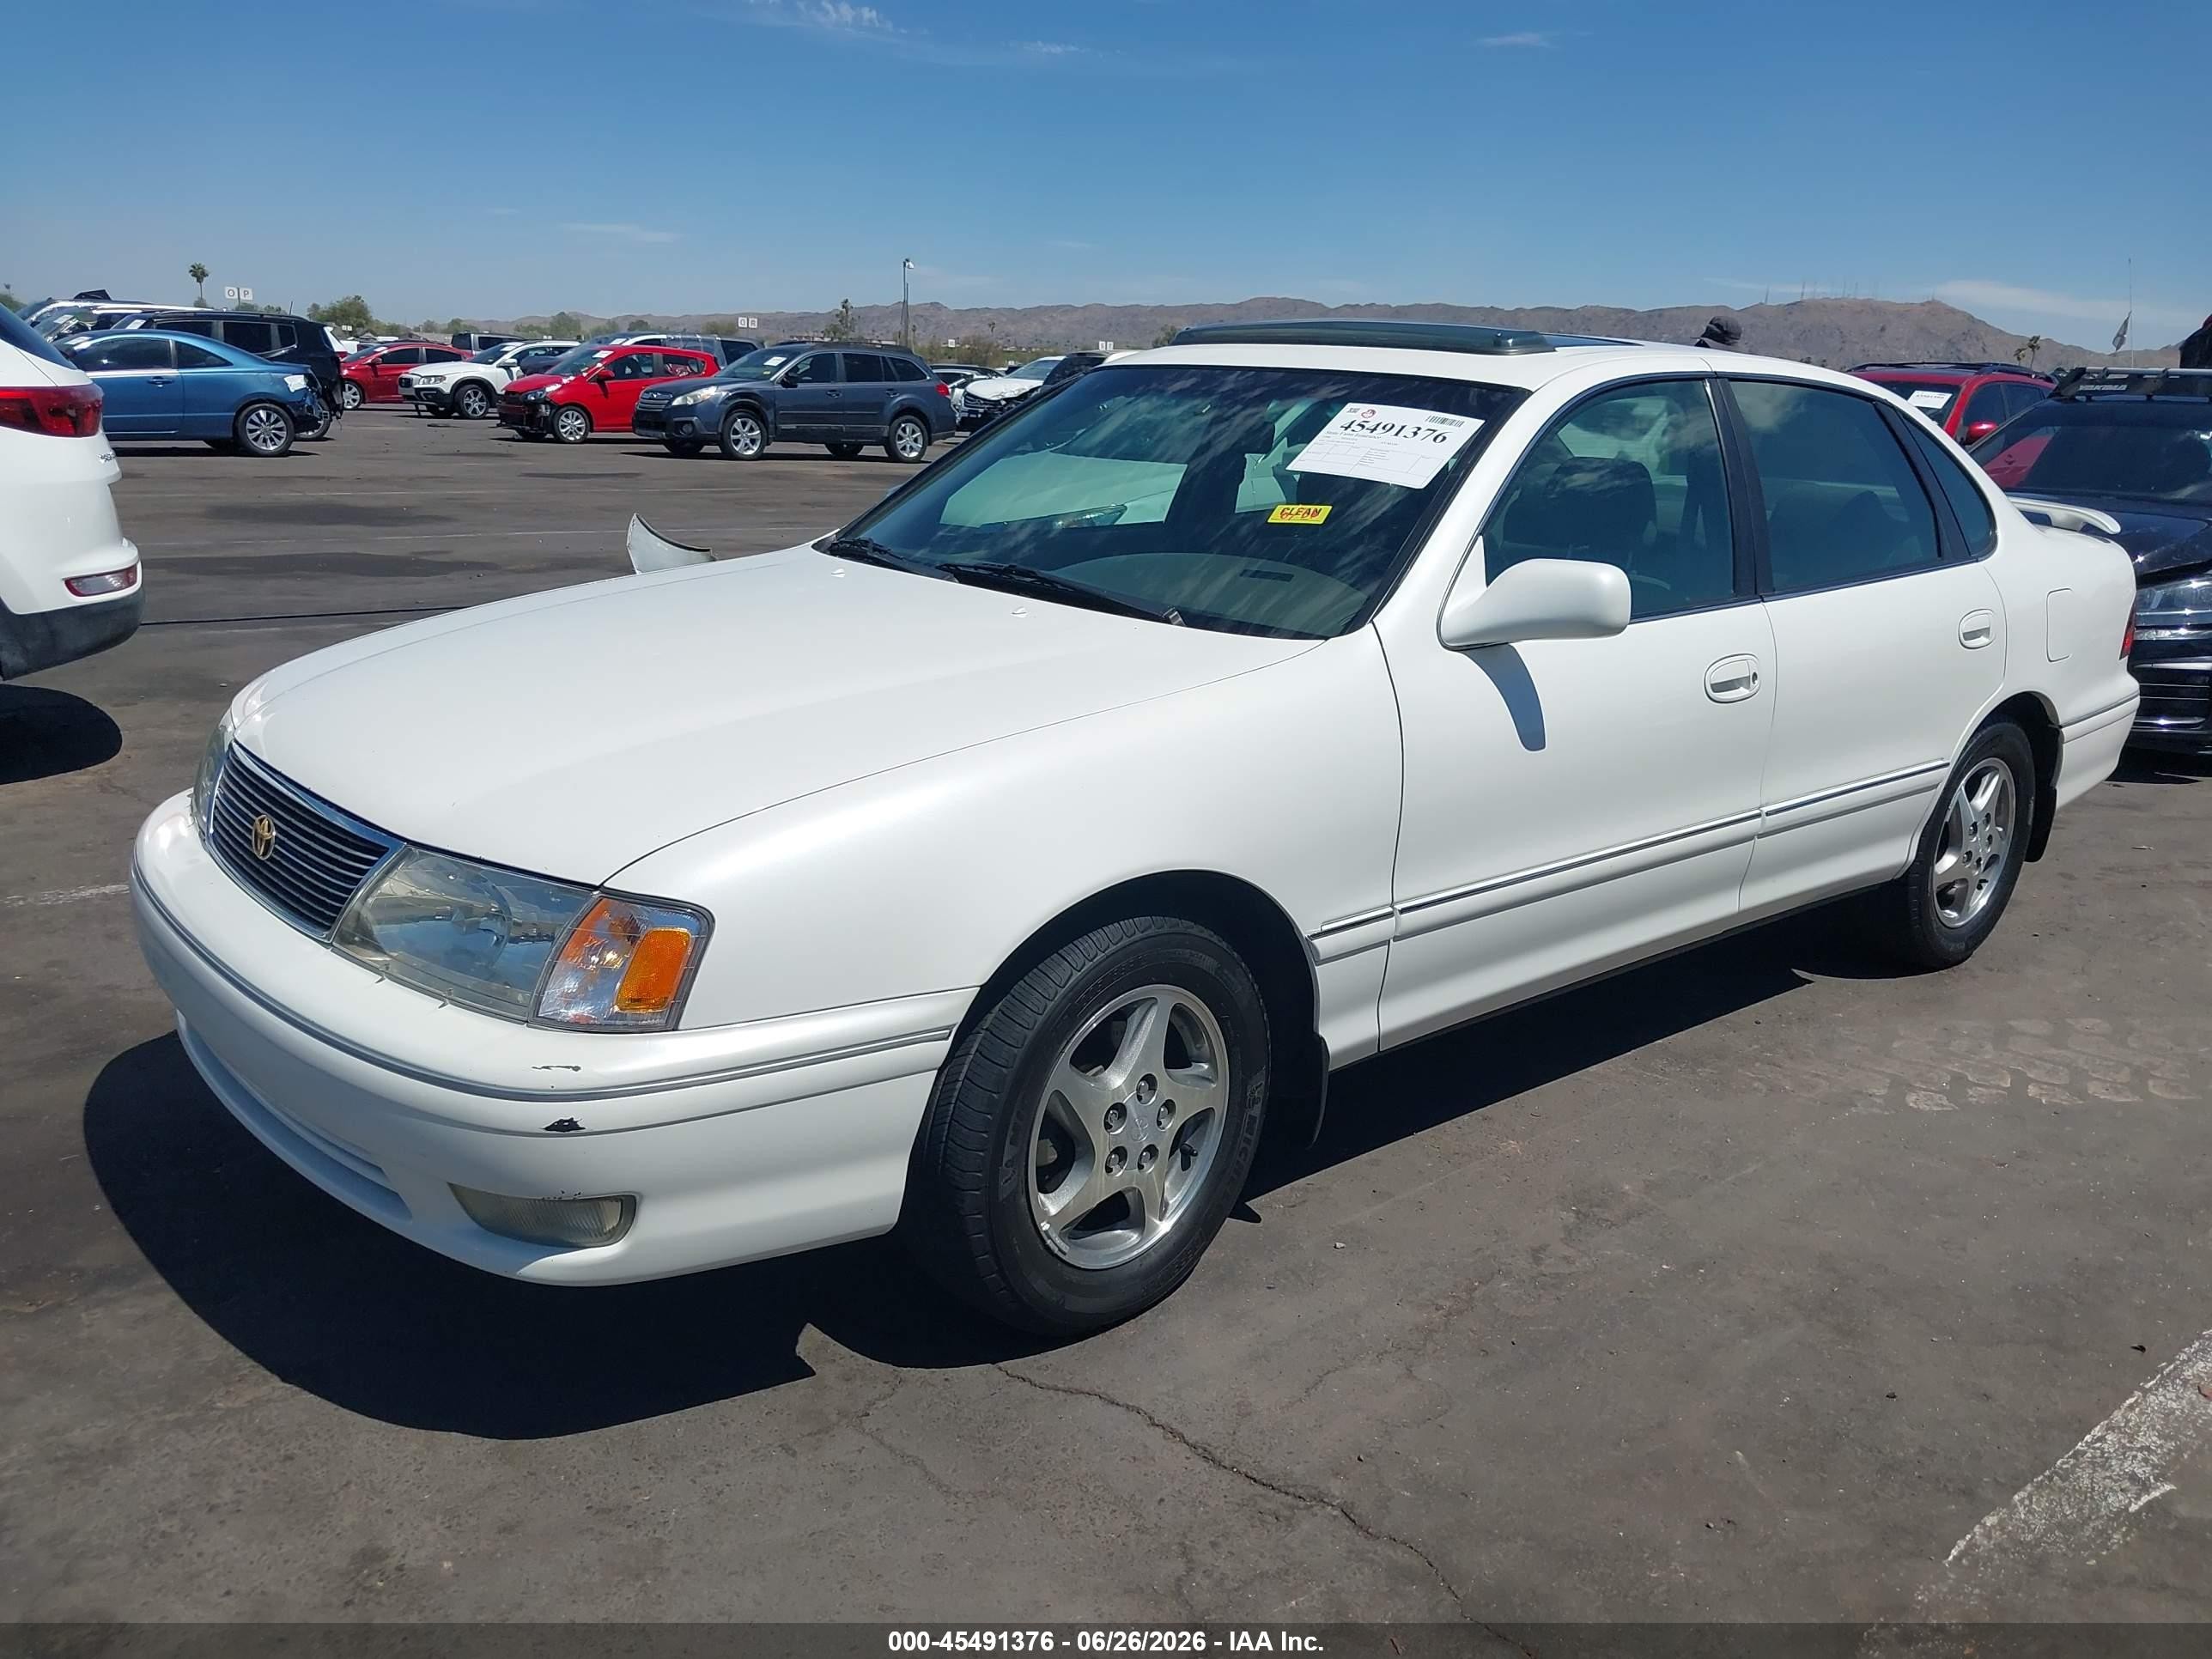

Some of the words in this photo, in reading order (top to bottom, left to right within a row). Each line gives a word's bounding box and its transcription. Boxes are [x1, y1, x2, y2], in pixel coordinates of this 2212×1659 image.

[228, 289, 235, 297] O
[243, 289, 249, 298] P
[1340, 419, 1453, 444] 45491376
